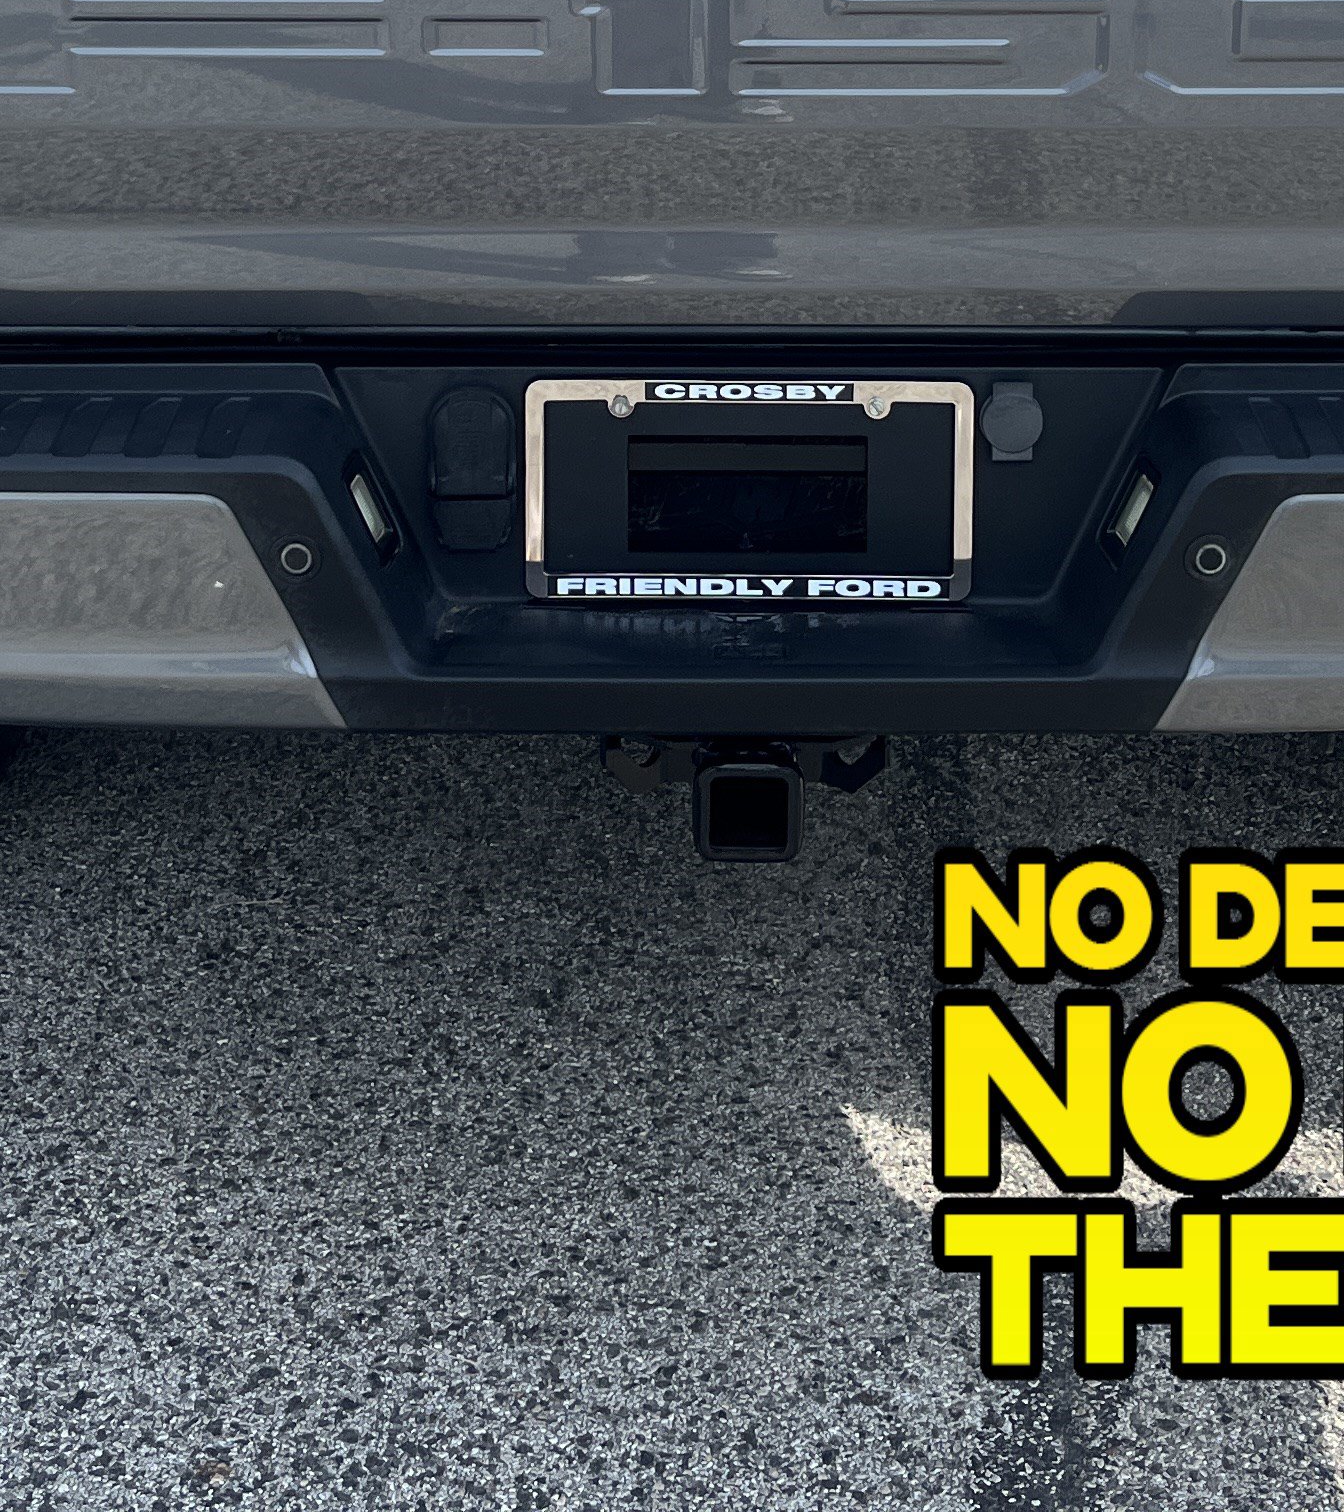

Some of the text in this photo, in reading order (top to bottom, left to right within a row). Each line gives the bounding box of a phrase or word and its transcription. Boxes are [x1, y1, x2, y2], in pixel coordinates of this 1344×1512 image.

[654, 383, 846, 400] CROSBY
[556, 577, 943, 597] FRIENDLY FORD
